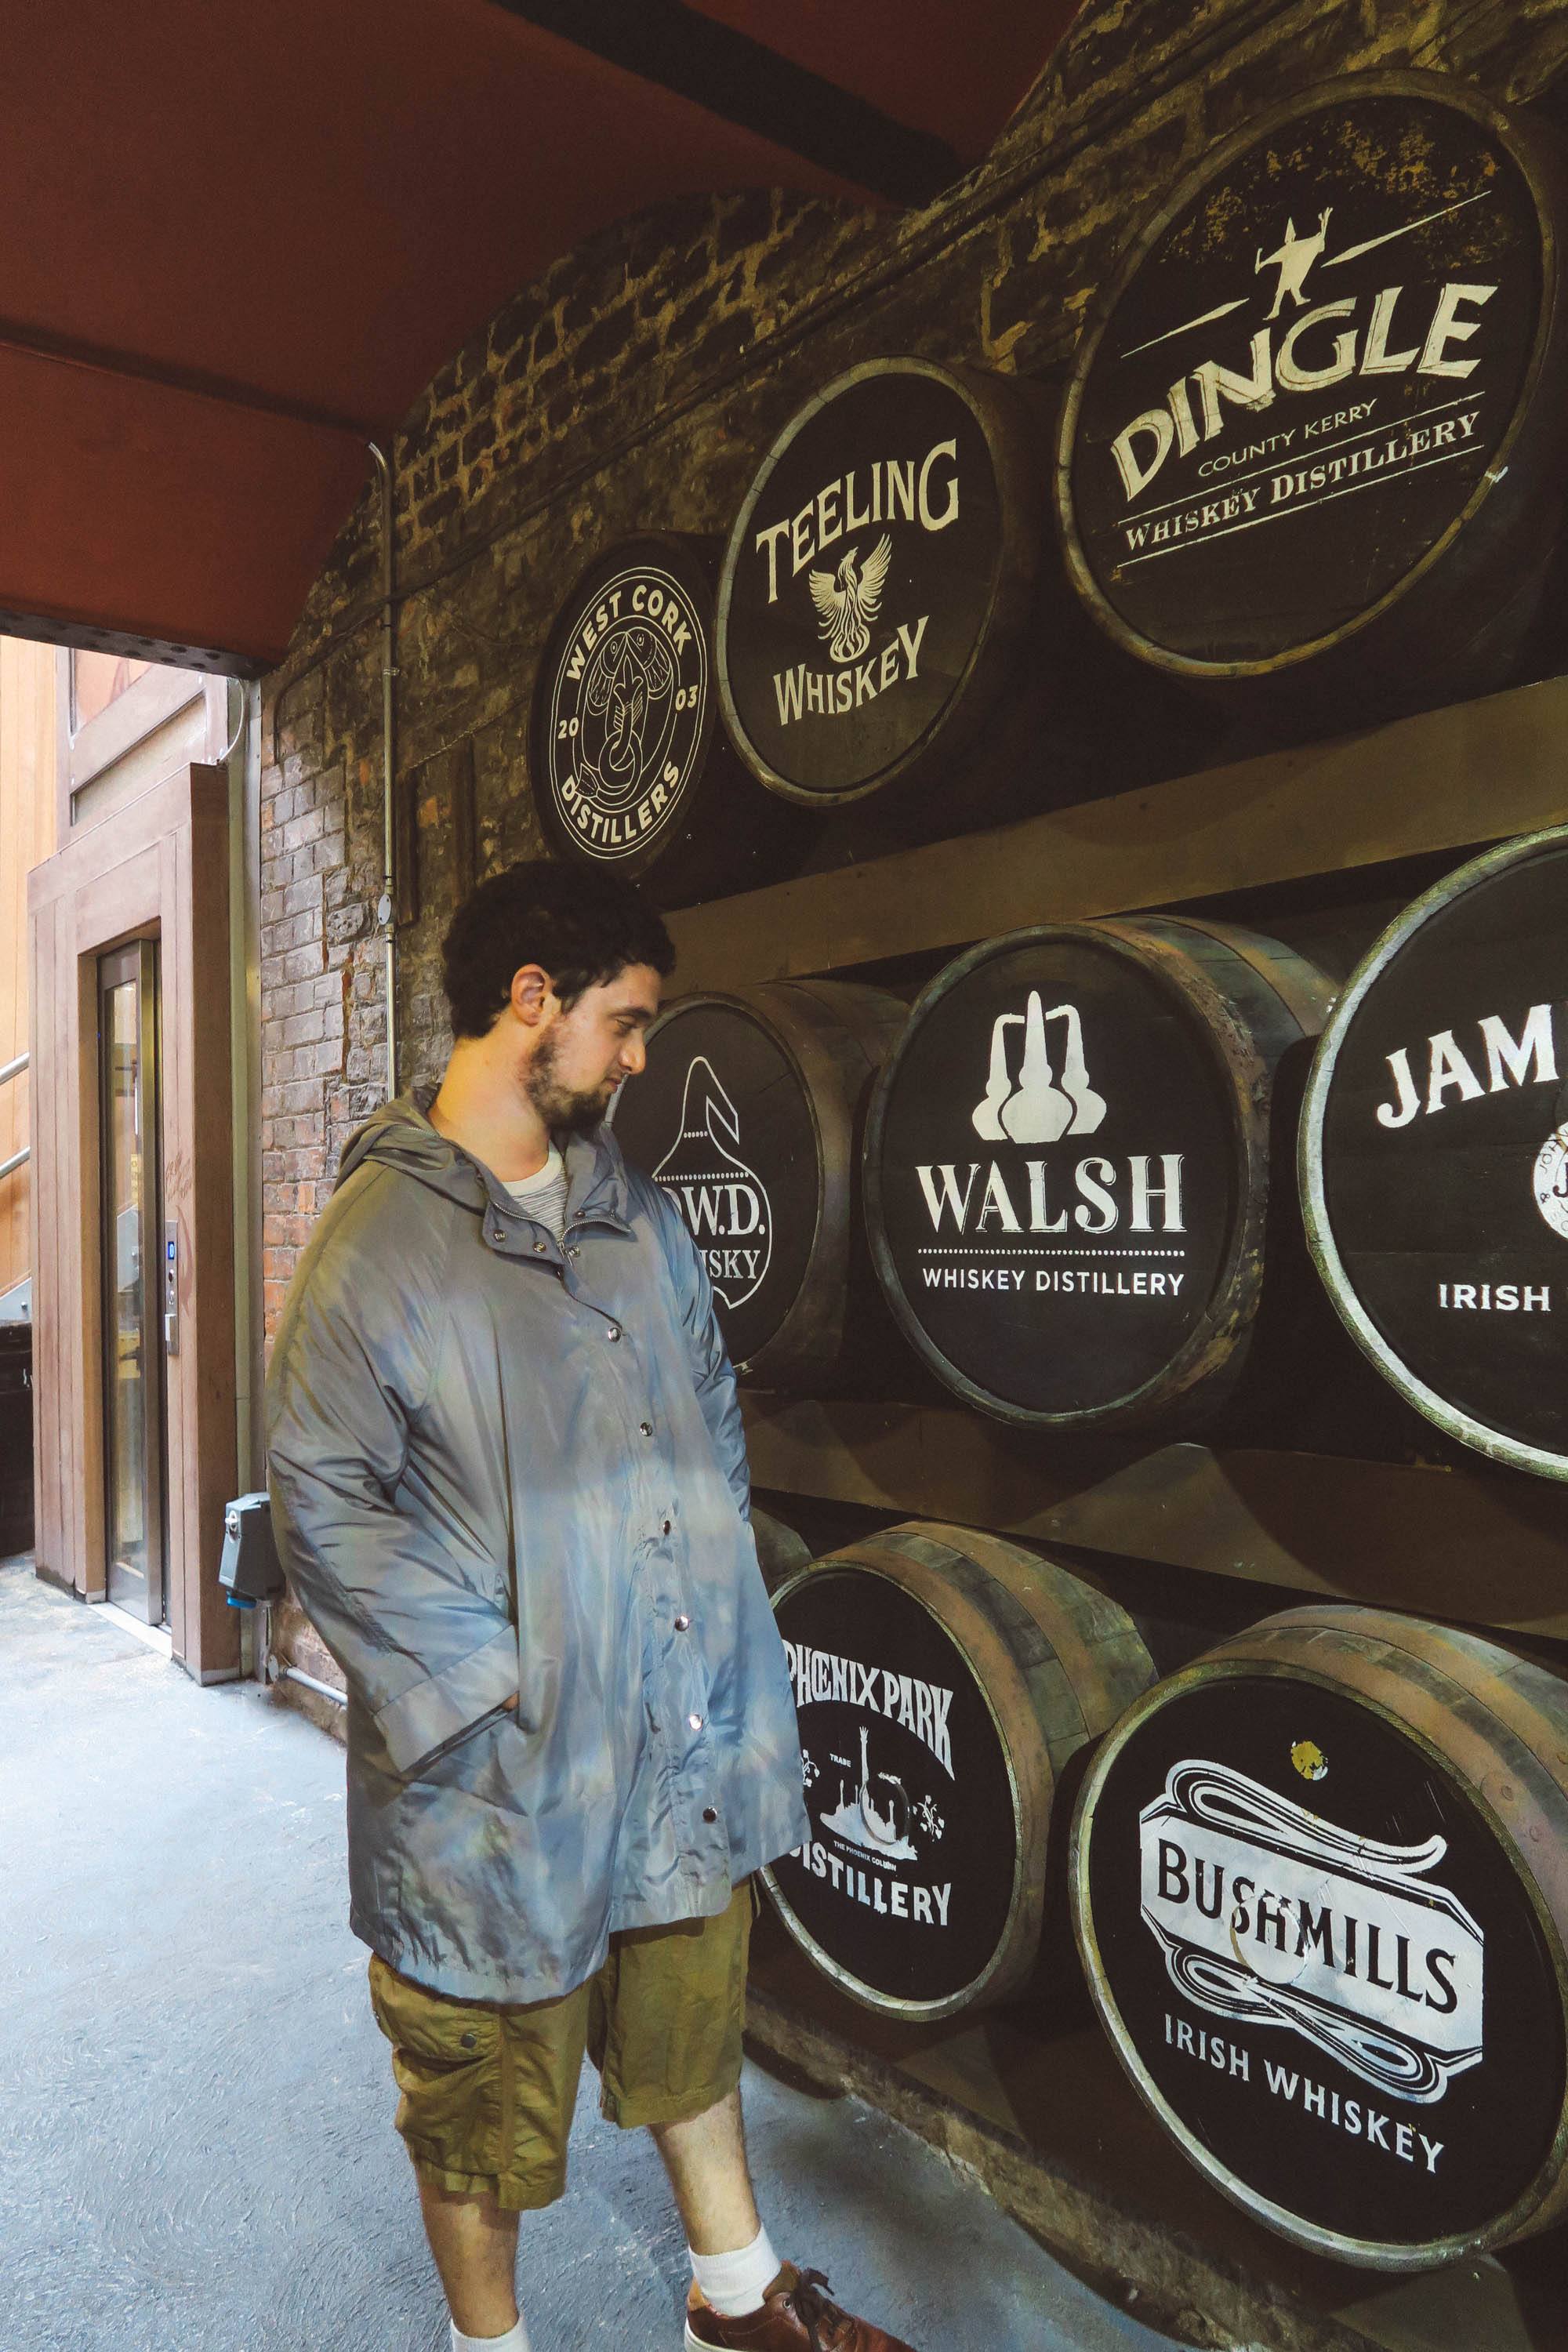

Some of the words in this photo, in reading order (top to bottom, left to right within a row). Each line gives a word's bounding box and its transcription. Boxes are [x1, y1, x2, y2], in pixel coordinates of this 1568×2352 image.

[1110, 283, 1498, 502] DINGLE
[1198, 429, 1296, 477] COUNTY
[1305, 398, 1377, 438] KERRY
[756, 438, 959, 604] TEELING
[1125, 487, 1260, 550] WHISKEY
[1269, 411, 1480, 504] DISTILLERY
[566, 591, 622, 681] WEST
[632, 585, 691, 655] CORK
[773, 615, 930, 726] WHISKEY
[557, 717, 579, 739] 20
[675, 685, 699, 711] 03
[561, 761, 679, 844] DISTILLERS
[915, 1154, 1187, 1235] WALSH
[922, 1268, 1025, 1290] WHISKEY
[1036, 1271, 1185, 1296] DISTILLERY
[1439, 1283, 1552, 1312] IRISH
[883, 1671, 955, 1780] PARK
[789, 1842, 952, 1926] ISTILLERY
[1156, 1838, 1459, 2015] BUSHMILLS
[1164, 2014, 1250, 2082] IRISH
[1264, 2059, 1445, 2174] WHISKEY
